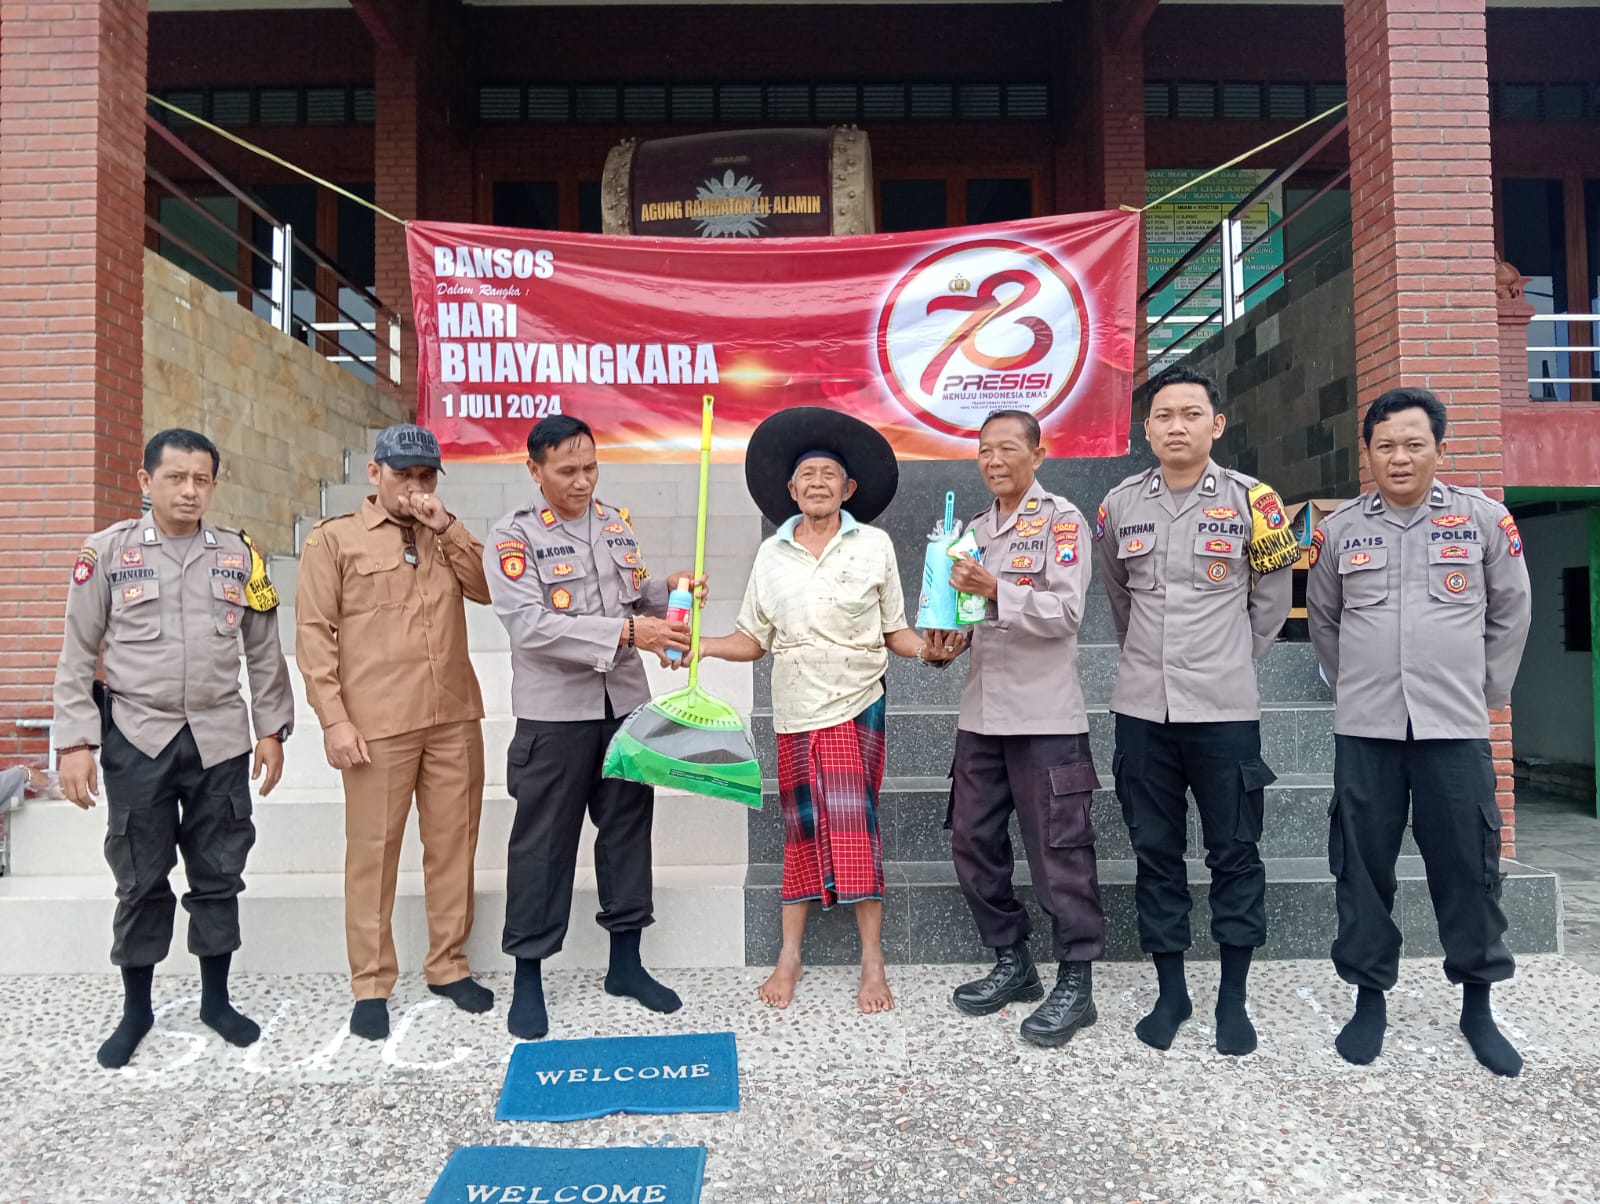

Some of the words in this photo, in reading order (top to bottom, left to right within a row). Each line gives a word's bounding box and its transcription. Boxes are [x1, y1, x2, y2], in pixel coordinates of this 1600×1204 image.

[641, 200, 683, 222] AGUNG
[772, 195, 821, 214] ALAMIN
[434, 246, 554, 279] BANSOS
[437, 283, 475, 297] Dalam
[479, 284, 521, 298] Rangka
[438, 302, 517, 338] HARI
[440, 343, 719, 385] BHAYANGKARA
[943, 373, 1053, 391] PRESISI
[942, 392, 977, 400] MENUJU
[979, 391, 1024, 400] INDONESIA
[1025, 390, 1048, 399] EMAS
[442, 395, 452, 418] 1
[458, 394, 502, 418] JULI
[506, 394, 562, 418] 2024
[399, 431, 434, 447] PUMA
[1119, 522, 1155, 538] FATKHAN
[1199, 522, 1244, 535] POLRI
[1431, 529, 1478, 542] POLRI
[1009, 540, 1044, 551] POLRI
[1343, 536, 1384, 549] JA'IS
[211, 568, 246, 583] POLRI
[535, 1063, 710, 1086] WELCOME
[466, 1184, 668, 1204] WELCOME
